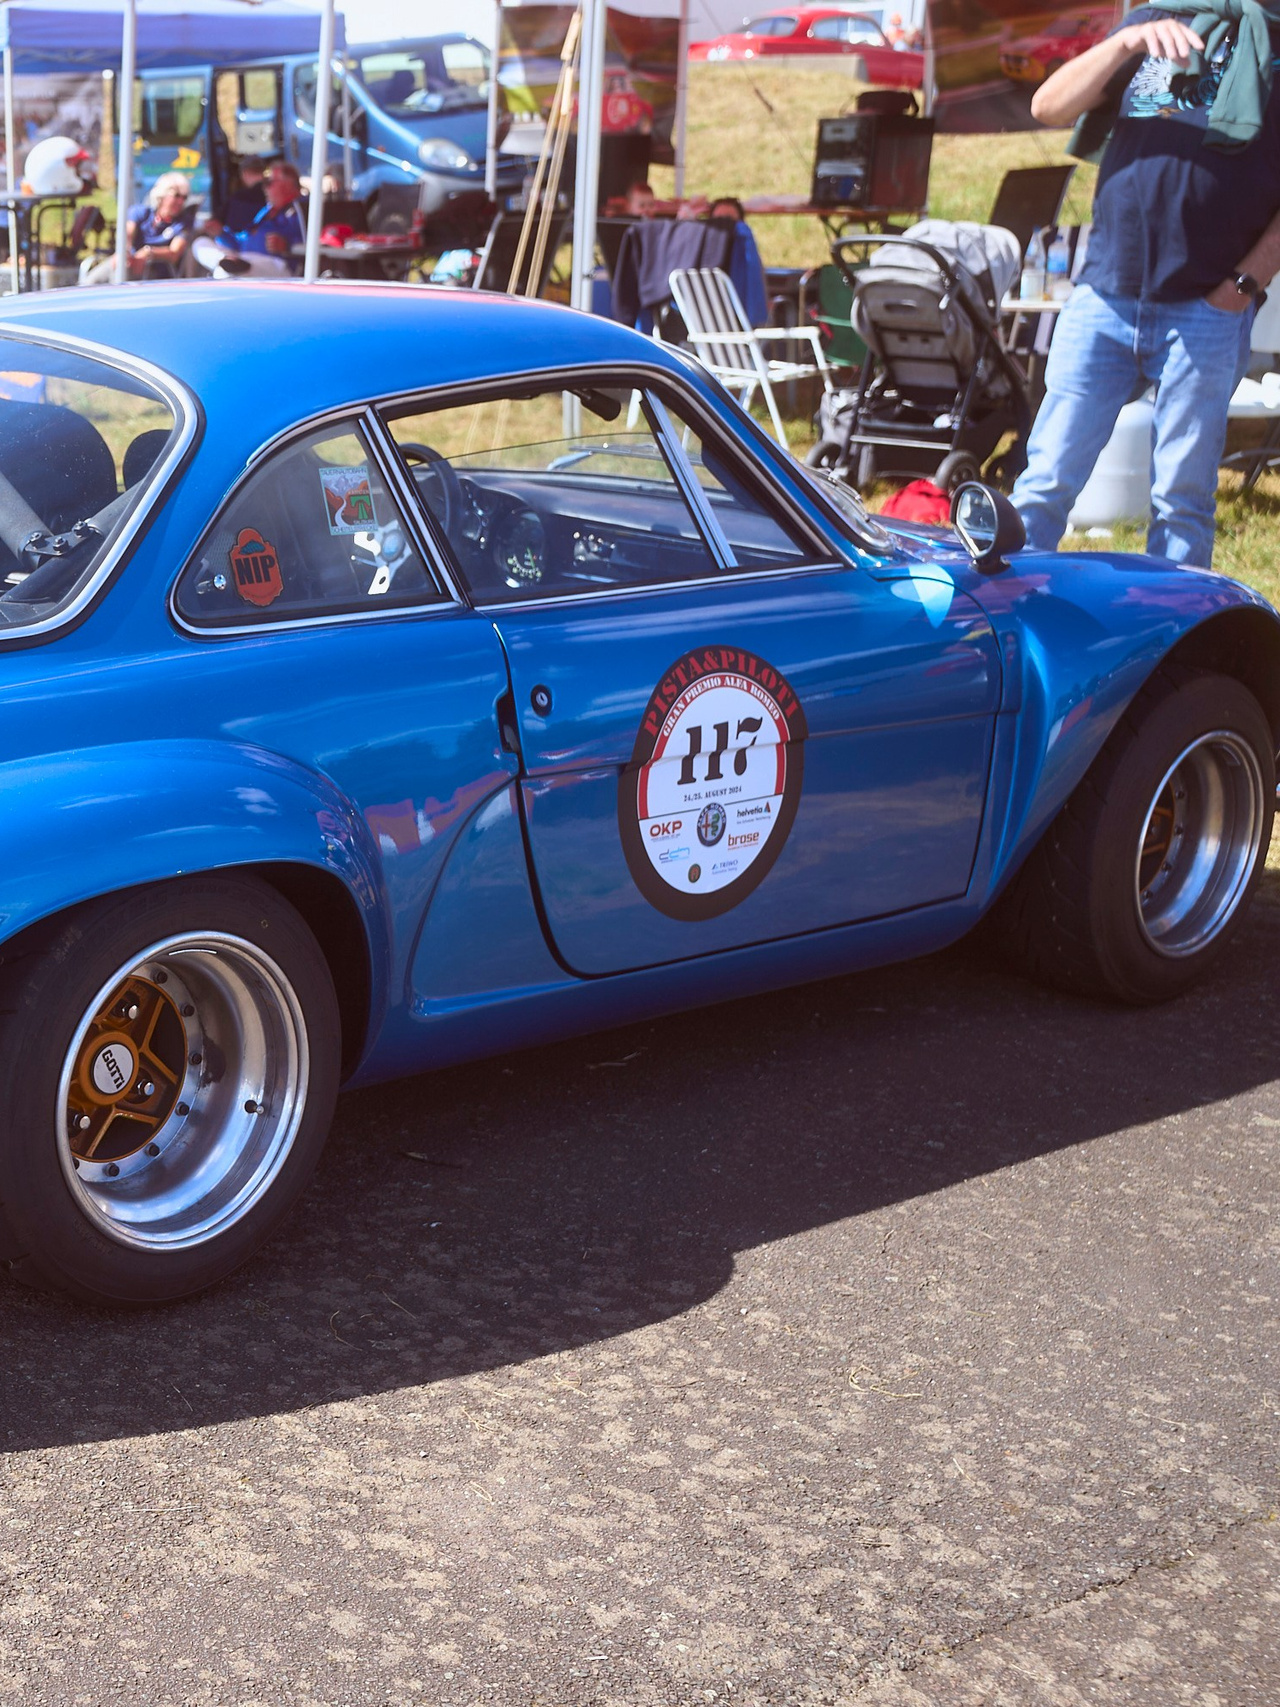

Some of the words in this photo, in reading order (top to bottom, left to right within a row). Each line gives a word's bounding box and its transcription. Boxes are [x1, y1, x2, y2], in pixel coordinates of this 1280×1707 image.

[235, 555, 276, 585] NIP
[663, 700, 686, 738] GRAN
[685, 675, 721, 702] PREMIO
[723, 676, 748, 692] ALFA
[750, 684, 781, 721] ROMEO
[677, 717, 763, 785] 117
[736, 805, 763, 818] helvetia
[649, 820, 683, 837] OKP
[727, 832, 760, 847] brose
